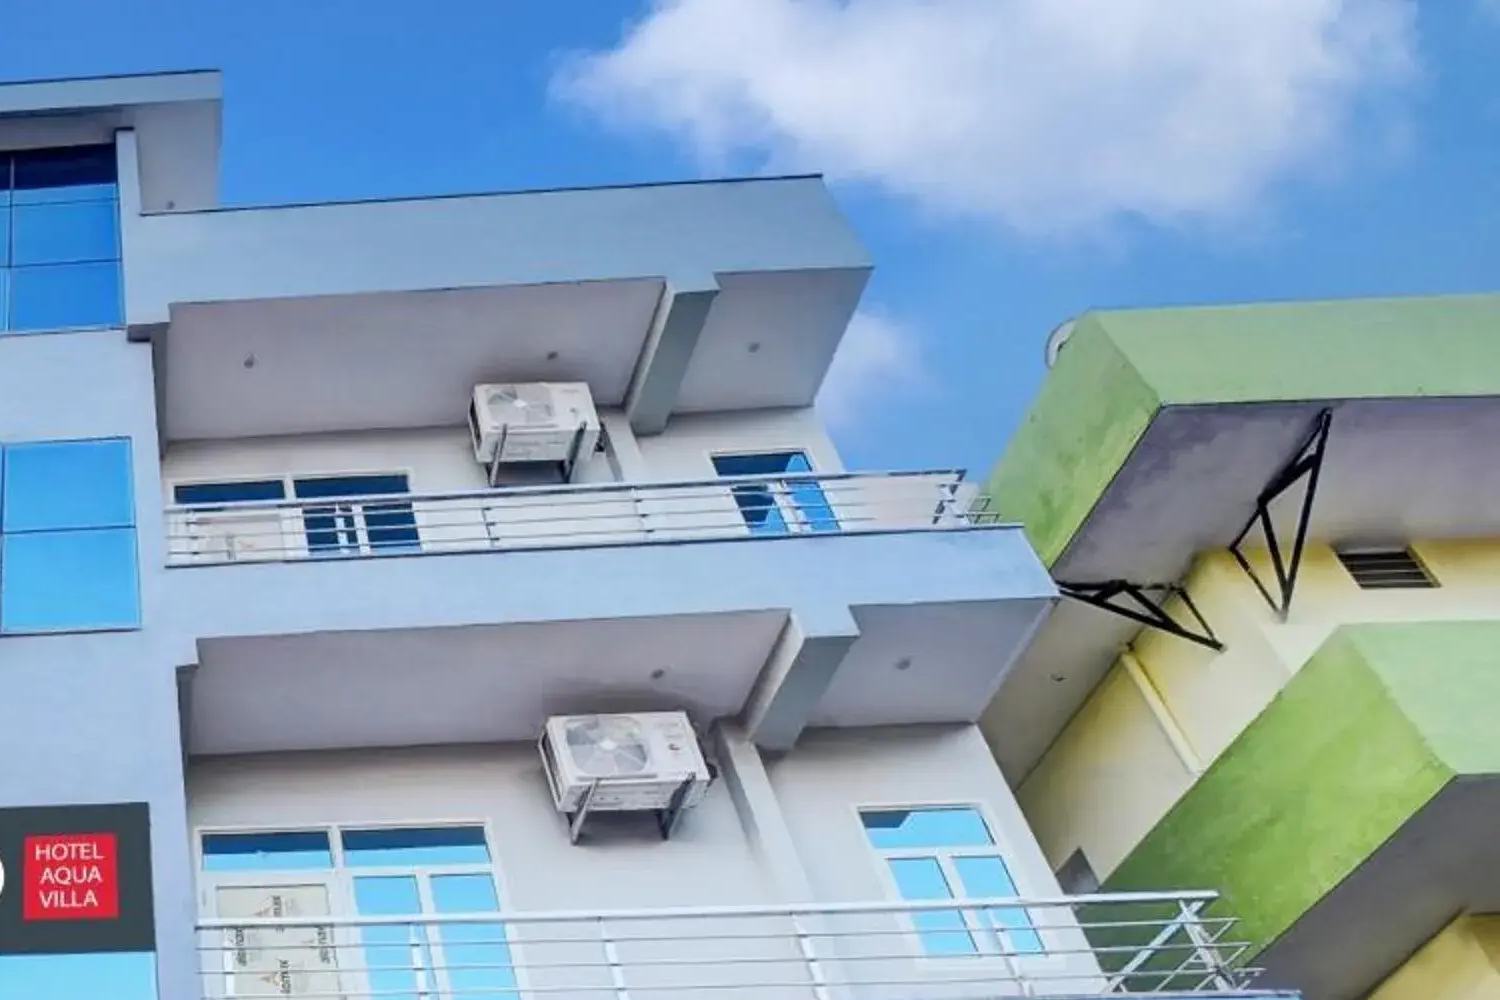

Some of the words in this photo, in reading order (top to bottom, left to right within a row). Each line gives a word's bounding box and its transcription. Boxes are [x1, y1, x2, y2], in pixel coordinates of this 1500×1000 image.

[35, 841, 105, 861] HOTEL
[38, 865, 103, 886] AQUA
[38, 889, 99, 909] VILLA
